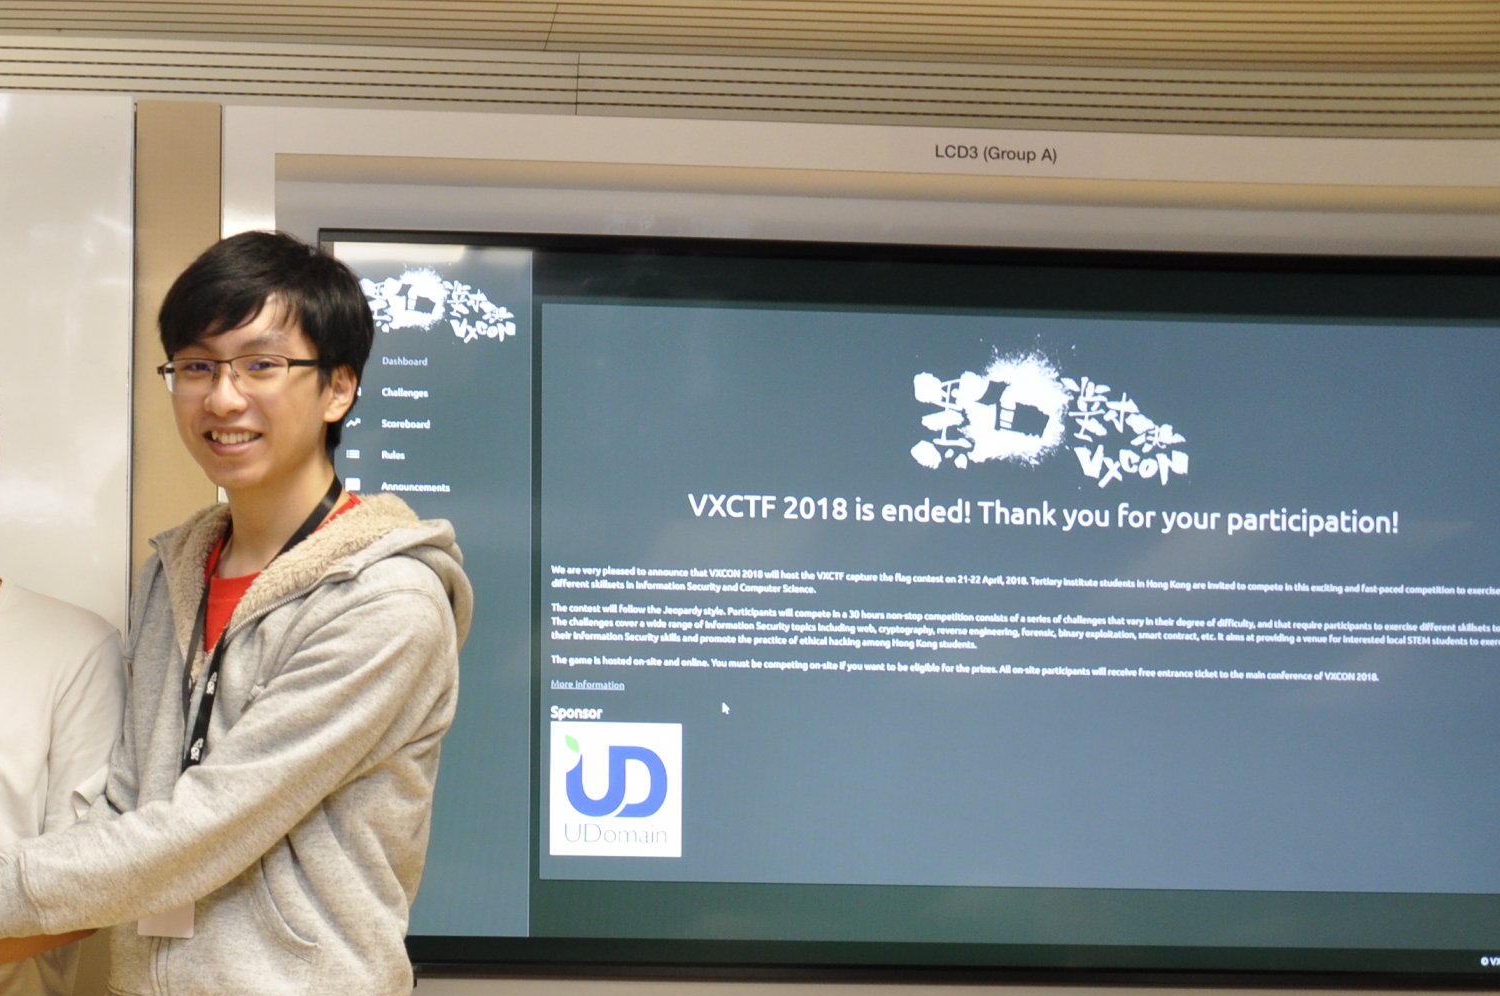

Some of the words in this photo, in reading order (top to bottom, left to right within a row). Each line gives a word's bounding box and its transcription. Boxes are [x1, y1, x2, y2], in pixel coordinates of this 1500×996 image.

[935, 144, 978, 159] LCD3
[983, 146, 1037, 164] (Group
[1041, 148, 1058, 165] A)
[381, 356, 428, 367] Dashboard
[381, 387, 429, 400] Challenges
[381, 419, 431, 429] Scoreboard
[381, 450, 405, 460] Rules
[381, 481, 450, 492] Announcements
[687, 493, 777, 519] VXCTF
[783, 495, 848, 521] 2018
[855, 497, 875, 521] is
[882, 497, 971, 524] ended!
[977, 499, 1057, 526] Thank
[1062, 507, 1110, 532] you
[1117, 502, 1156, 529] for
[1161, 508, 1221, 534] your
[1227, 507, 1399, 537] participation!
[550, 578, 590, 588] different
[590, 579, 625, 589] skillsets
[635, 580, 686, 590] Information
[686, 582, 721, 593] Security
[739, 583, 781, 594] Computer
[602, 566, 636, 577] pleased
[647, 569, 689, 577] announce
[816, 571, 844, 580] VXCTF
[845, 573, 878, 583] capture
[912, 574, 944, 583] contest
[957, 575, 981, 584] 21-22
[1030, 576, 1062, 588] Tertiary
[1063, 578, 1098, 587] institute
[1099, 578, 1135, 588] students
[1207, 580, 1236, 590] invited
[1247, 583, 1283, 592] compete
[1310, 583, 1343, 594] exciting
[1361, 584, 1404, 595] fast-paced
[1404, 585, 1455, 596] competition
[568, 604, 601, 613] contest
[618, 604, 646, 614] follow
[662, 605, 702, 617] Jeopardy
[727, 607, 777, 618] Participants
[794, 609, 831, 620] compete
[861, 609, 885, 619] hours
[886, 612, 923, 622] non-stop
[923, 612, 974, 623] competition
[975, 613, 1008, 622] consists
[1026, 614, 1051, 623] series
[1062, 615, 1106, 626] challenges
[1154, 617, 1174, 626] their
[1175, 617, 1205, 629] degree
[1292, 620, 1322, 631] require
[1323, 621, 1372, 632] participants
[1384, 622, 1418, 631] exercise
[1419, 622, 1456, 632] different
[1457, 622, 1491, 632] skillsets
[550, 630, 572, 640] their
[573, 631, 623, 640] Information
[624, 632, 659, 643] Security
[660, 632, 681, 642] skills
[699, 635, 736, 645] promote
[753, 635, 787, 646] practice
[799, 635, 827, 645] ethical
[828, 636, 861, 648] hacking
[861, 640, 891, 649] among
[568, 617, 614, 629] challenges
[668, 621, 693, 631] range
[704, 620, 755, 630] Information
[756, 621, 790, 632] Security
[791, 622, 816, 633] topics
[817, 622, 856, 634] including
[1058, 628, 1084, 639] binary
[1138, 631, 1162, 639] smart
[1256, 633, 1295, 644] providing
[1342, 634, 1385, 644] interested
[1386, 635, 1406, 644] local
[1432, 636, 1468, 646] students
[1480, 638, 1500, 646] exer
[602, 655, 632, 665] hosted
[633, 657, 662, 666] on-site
[763, 660, 808, 671] competing
[809, 660, 838, 670] on-site
[909, 662, 940, 674] eligible
[1012, 665, 1040, 674] on-site
[1041, 666, 1090, 677] participants
[1107, 668, 1137, 677] receive
[1156, 669, 1193, 678] entrance
[1194, 669, 1218, 678] ticket
[1266, 670, 1312, 680] conference
[551, 679, 574, 690] More
[550, 705, 603, 721] Sponsor
[565, 745, 668, 818] UD
[564, 823, 668, 844] UDomain
